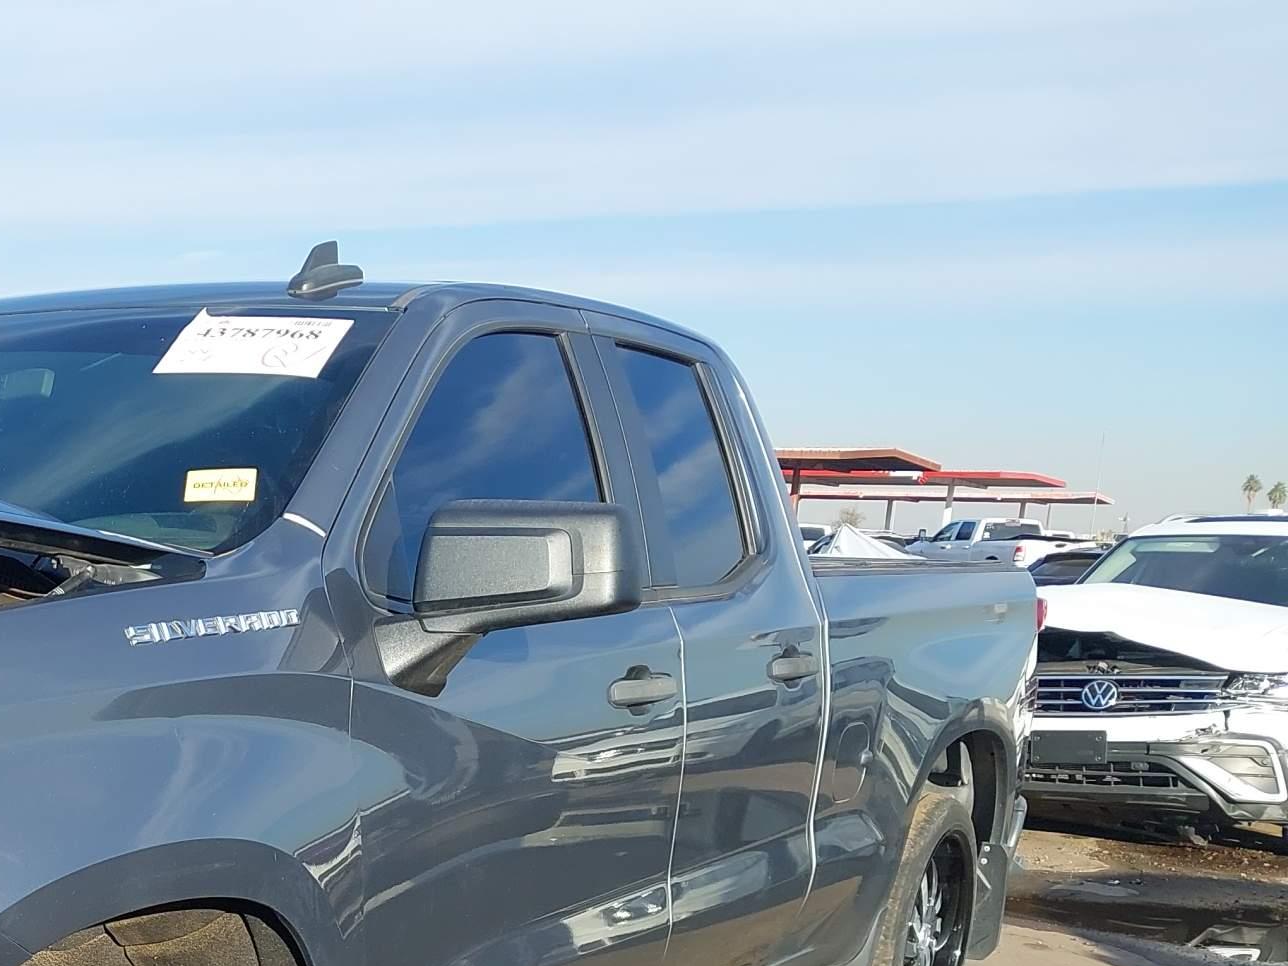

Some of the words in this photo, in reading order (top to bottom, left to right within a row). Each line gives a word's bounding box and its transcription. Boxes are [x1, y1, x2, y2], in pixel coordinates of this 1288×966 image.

[197, 327, 323, 340] 43787968
[193, 479, 249, 489] DETAILED
[124, 608, 300, 646] SILVERADO
